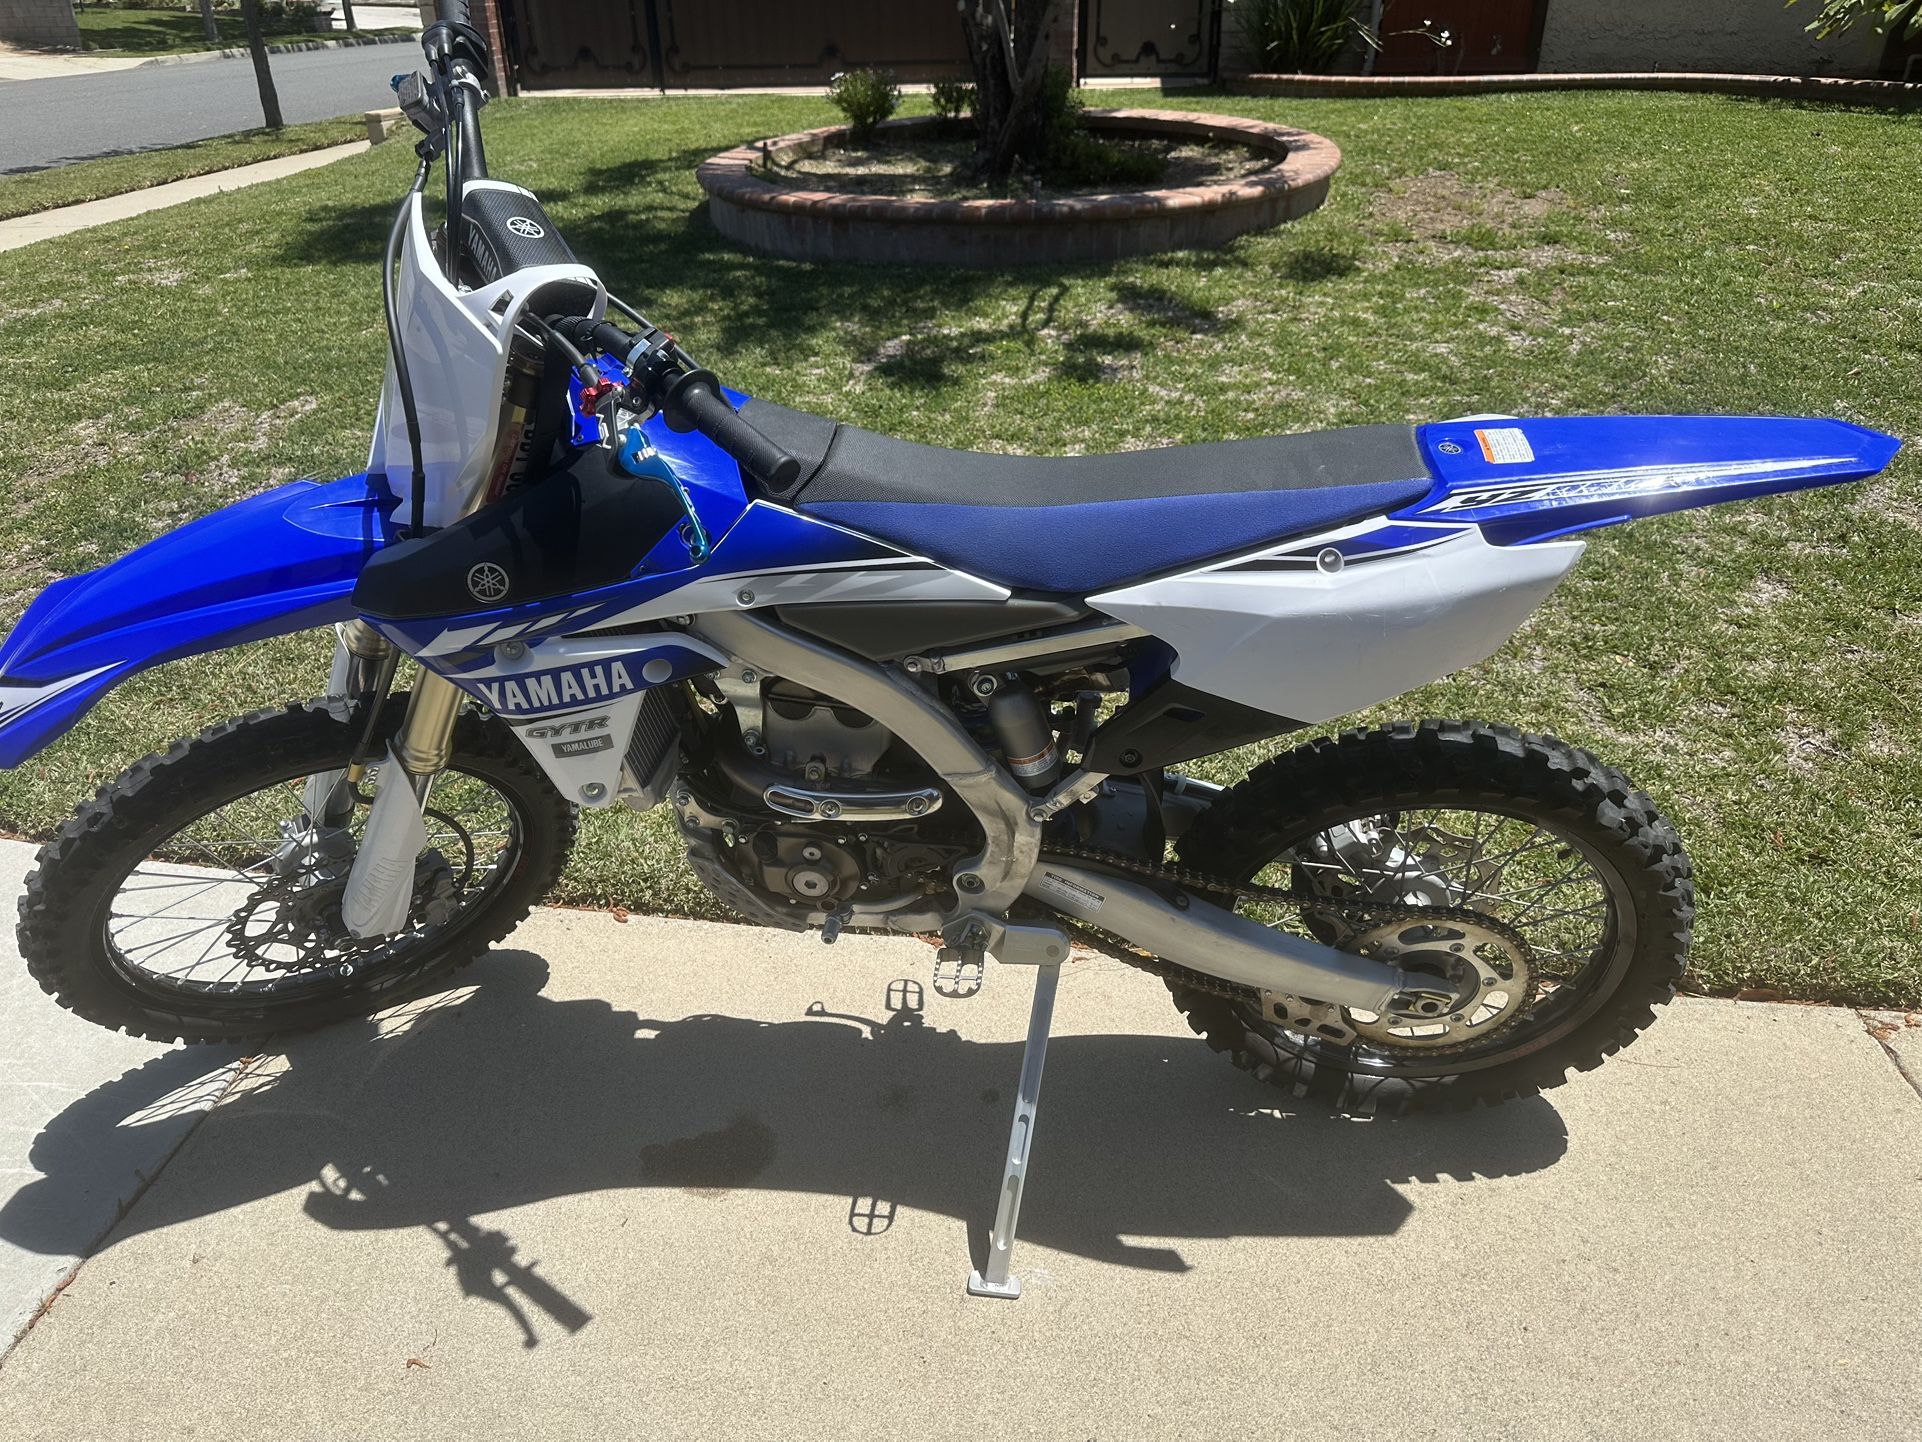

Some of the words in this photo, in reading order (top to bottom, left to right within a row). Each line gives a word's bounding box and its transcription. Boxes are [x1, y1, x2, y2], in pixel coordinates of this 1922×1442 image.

[468, 223, 497, 282] YAMAHA
[477, 660, 634, 710] YAMAHA
[525, 715, 611, 739] GYTR
[561, 738, 604, 753] YAMALUBE
